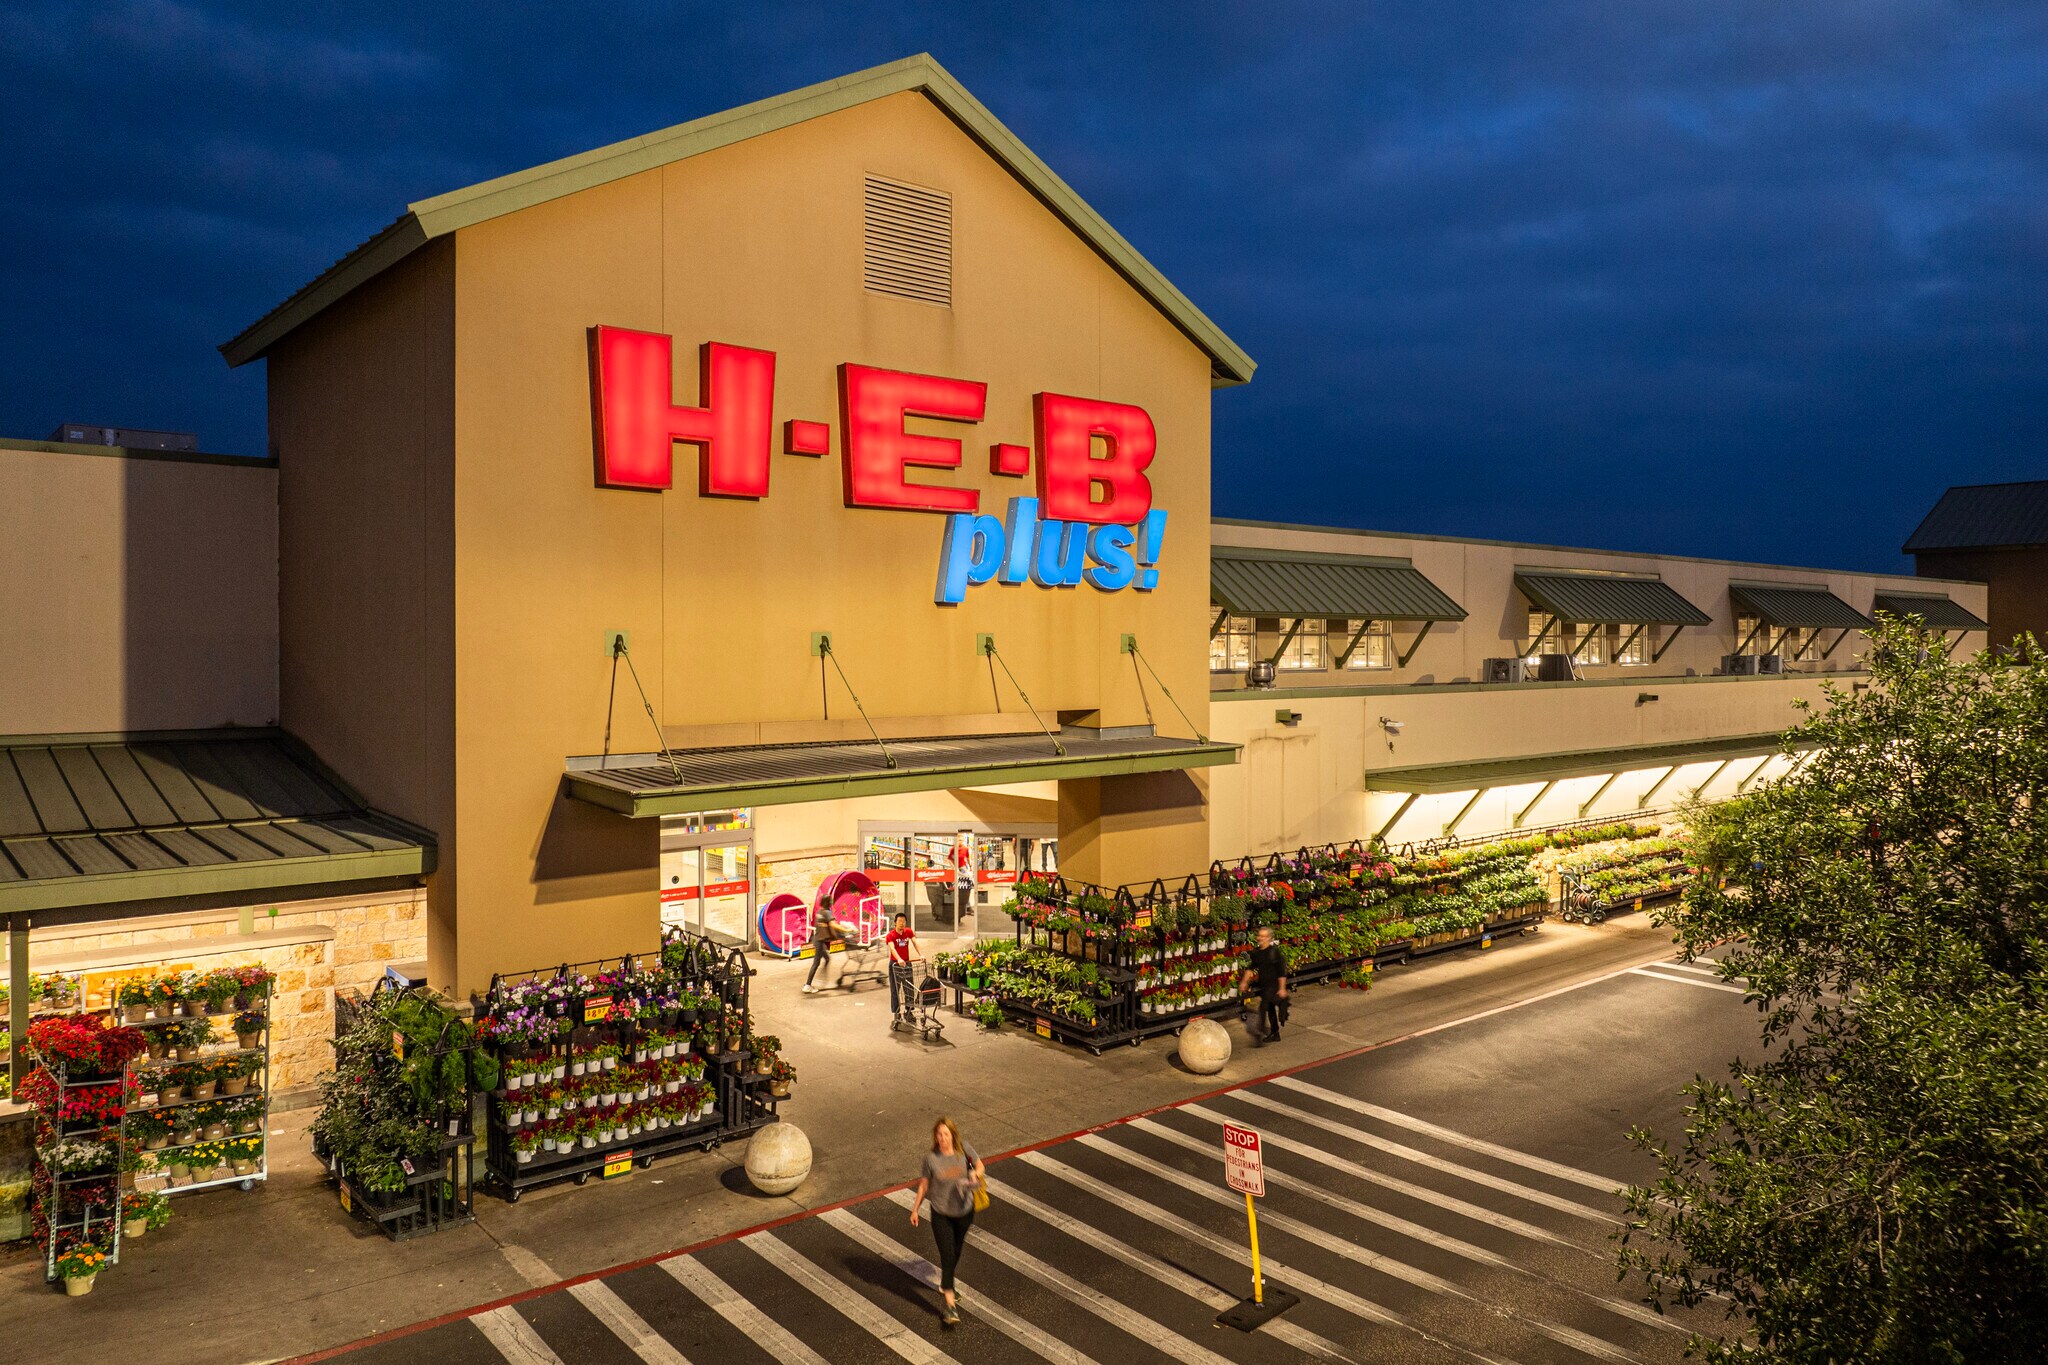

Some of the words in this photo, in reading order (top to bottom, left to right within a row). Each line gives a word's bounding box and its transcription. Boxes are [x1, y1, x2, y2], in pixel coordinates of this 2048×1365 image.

[934, 496, 1169, 607] plus!
[917, 871, 945, 879] Welcome
[986, 871, 1015, 879] Welcome
[1225, 1128, 1255, 1147] STOP
[1235, 1148, 1246, 1158] FOR
[1226, 1154, 1260, 1172] PEDESTRIANS
[1239, 1169, 1245, 1178] IN
[1229, 1175, 1260, 1192] CROSSWALK
